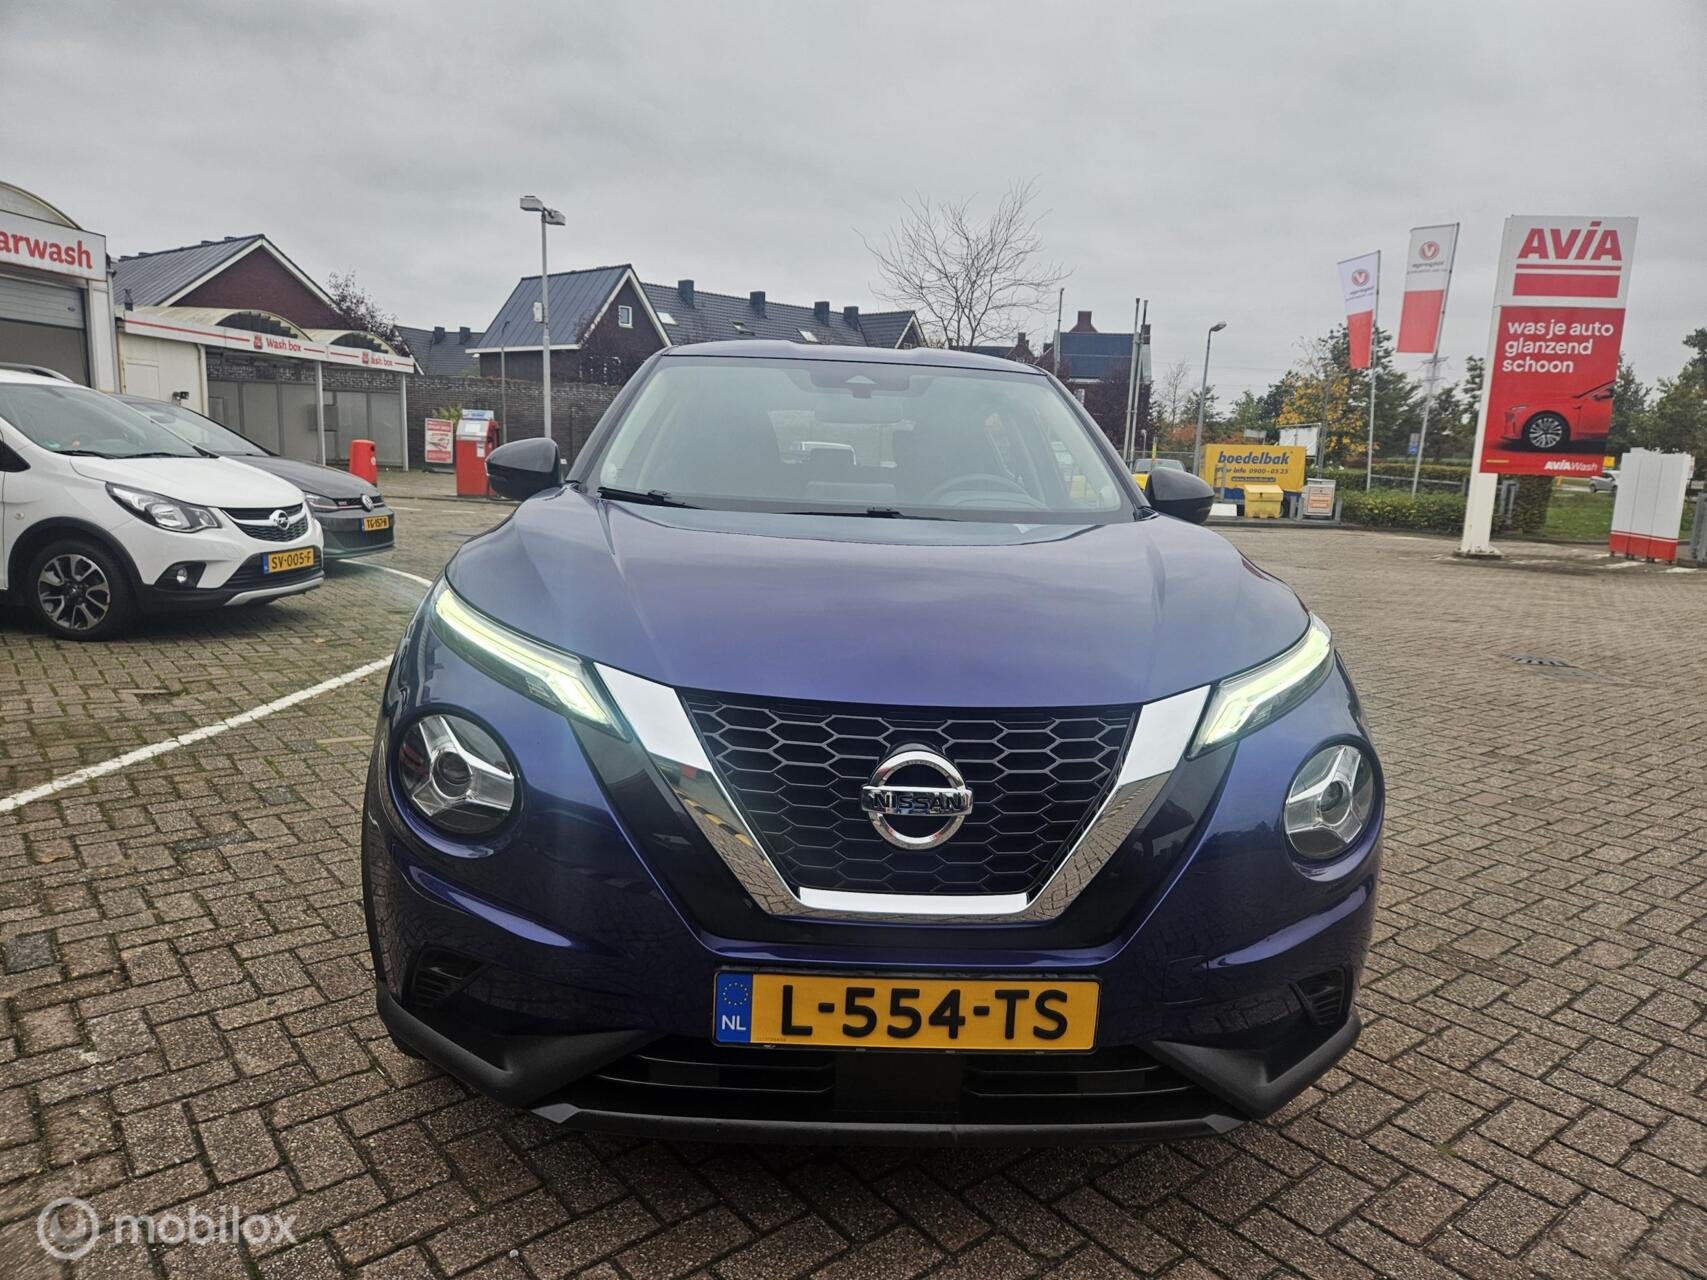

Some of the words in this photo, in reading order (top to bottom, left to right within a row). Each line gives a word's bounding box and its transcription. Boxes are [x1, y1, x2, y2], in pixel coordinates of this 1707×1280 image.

[1508, 322, 1546, 335] was
[1546, 319, 1567, 339] je
[1569, 321, 1614, 337] auto
[266, 338, 287, 350] Wash
[288, 341, 301, 352] box
[1504, 337, 1593, 357] glanzend
[1502, 356, 1574, 373] schoon
[1218, 451, 1290, 464] boedelbak
[271, 550, 312, 570] SV-005-F
[868, 790, 961, 814] NISSAN
[721, 1014, 747, 1031] NL
[781, 985, 1069, 1041] L-554-TS
